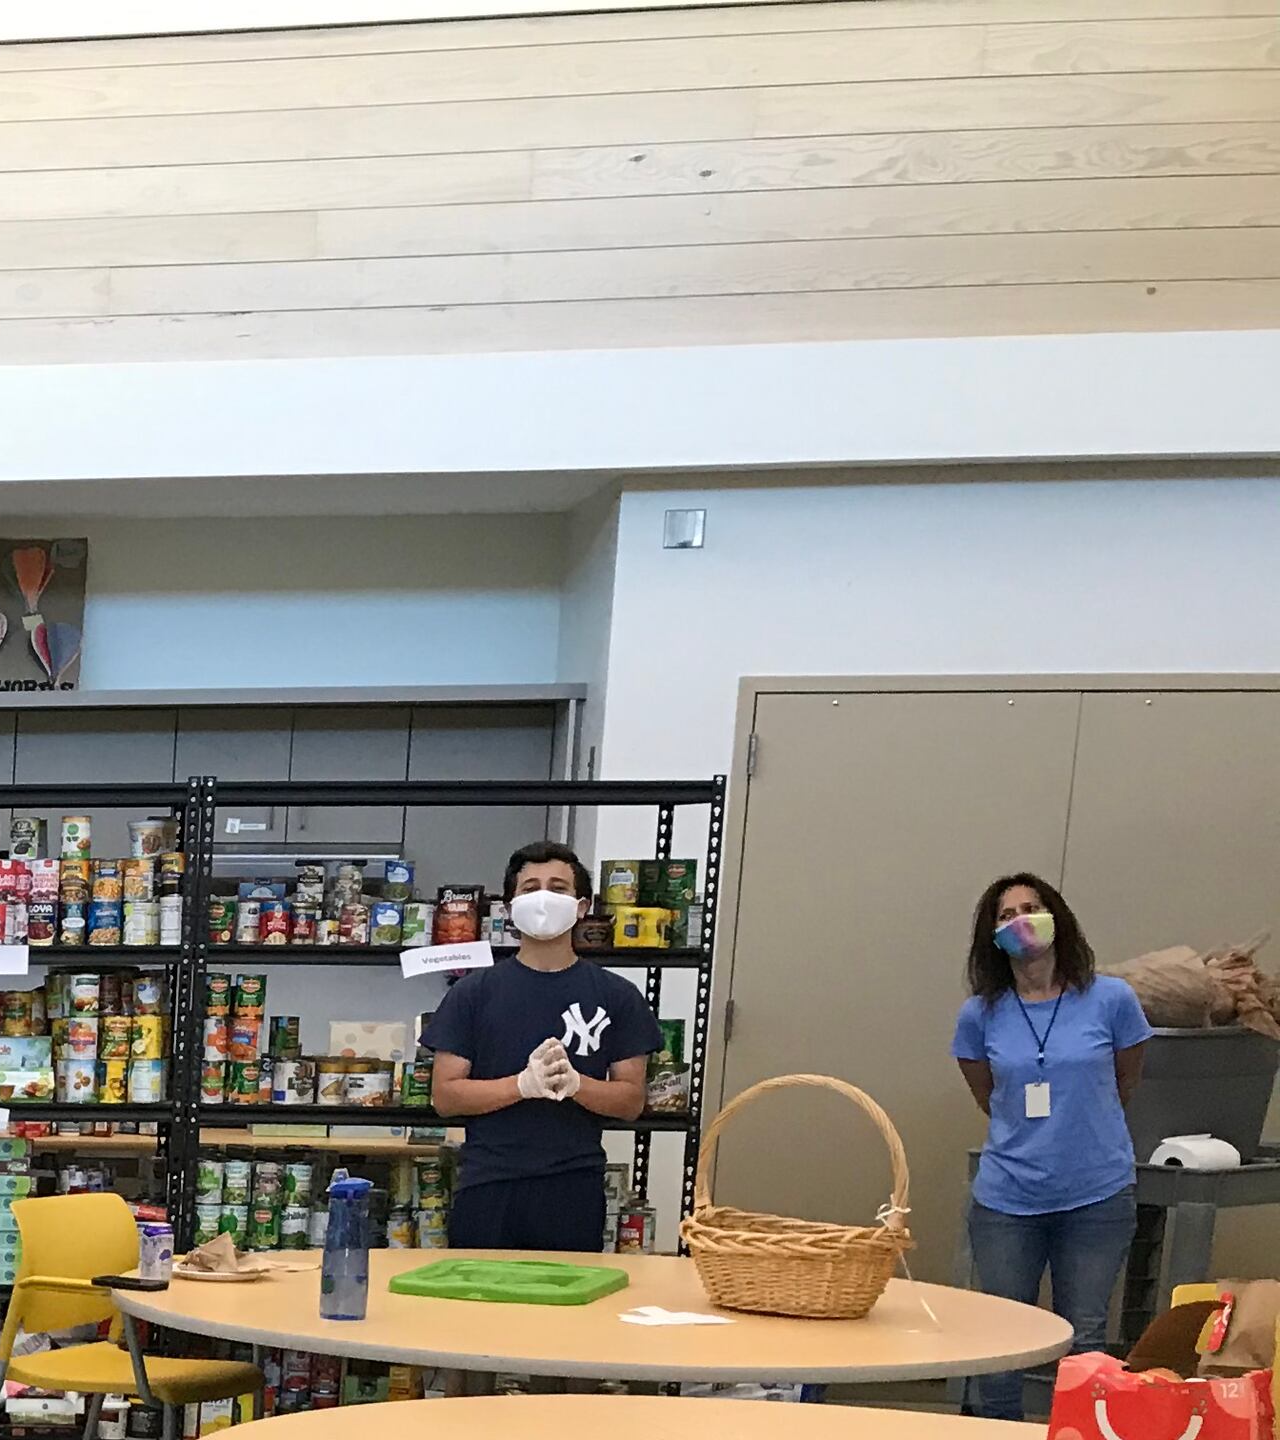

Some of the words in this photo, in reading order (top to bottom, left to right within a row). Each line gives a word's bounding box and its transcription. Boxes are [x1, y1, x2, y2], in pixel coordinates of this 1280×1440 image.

[421, 953, 472, 965] Vegetables
[560, 1002, 612, 1057] NY
[1219, 1382, 1239, 1399] 12
